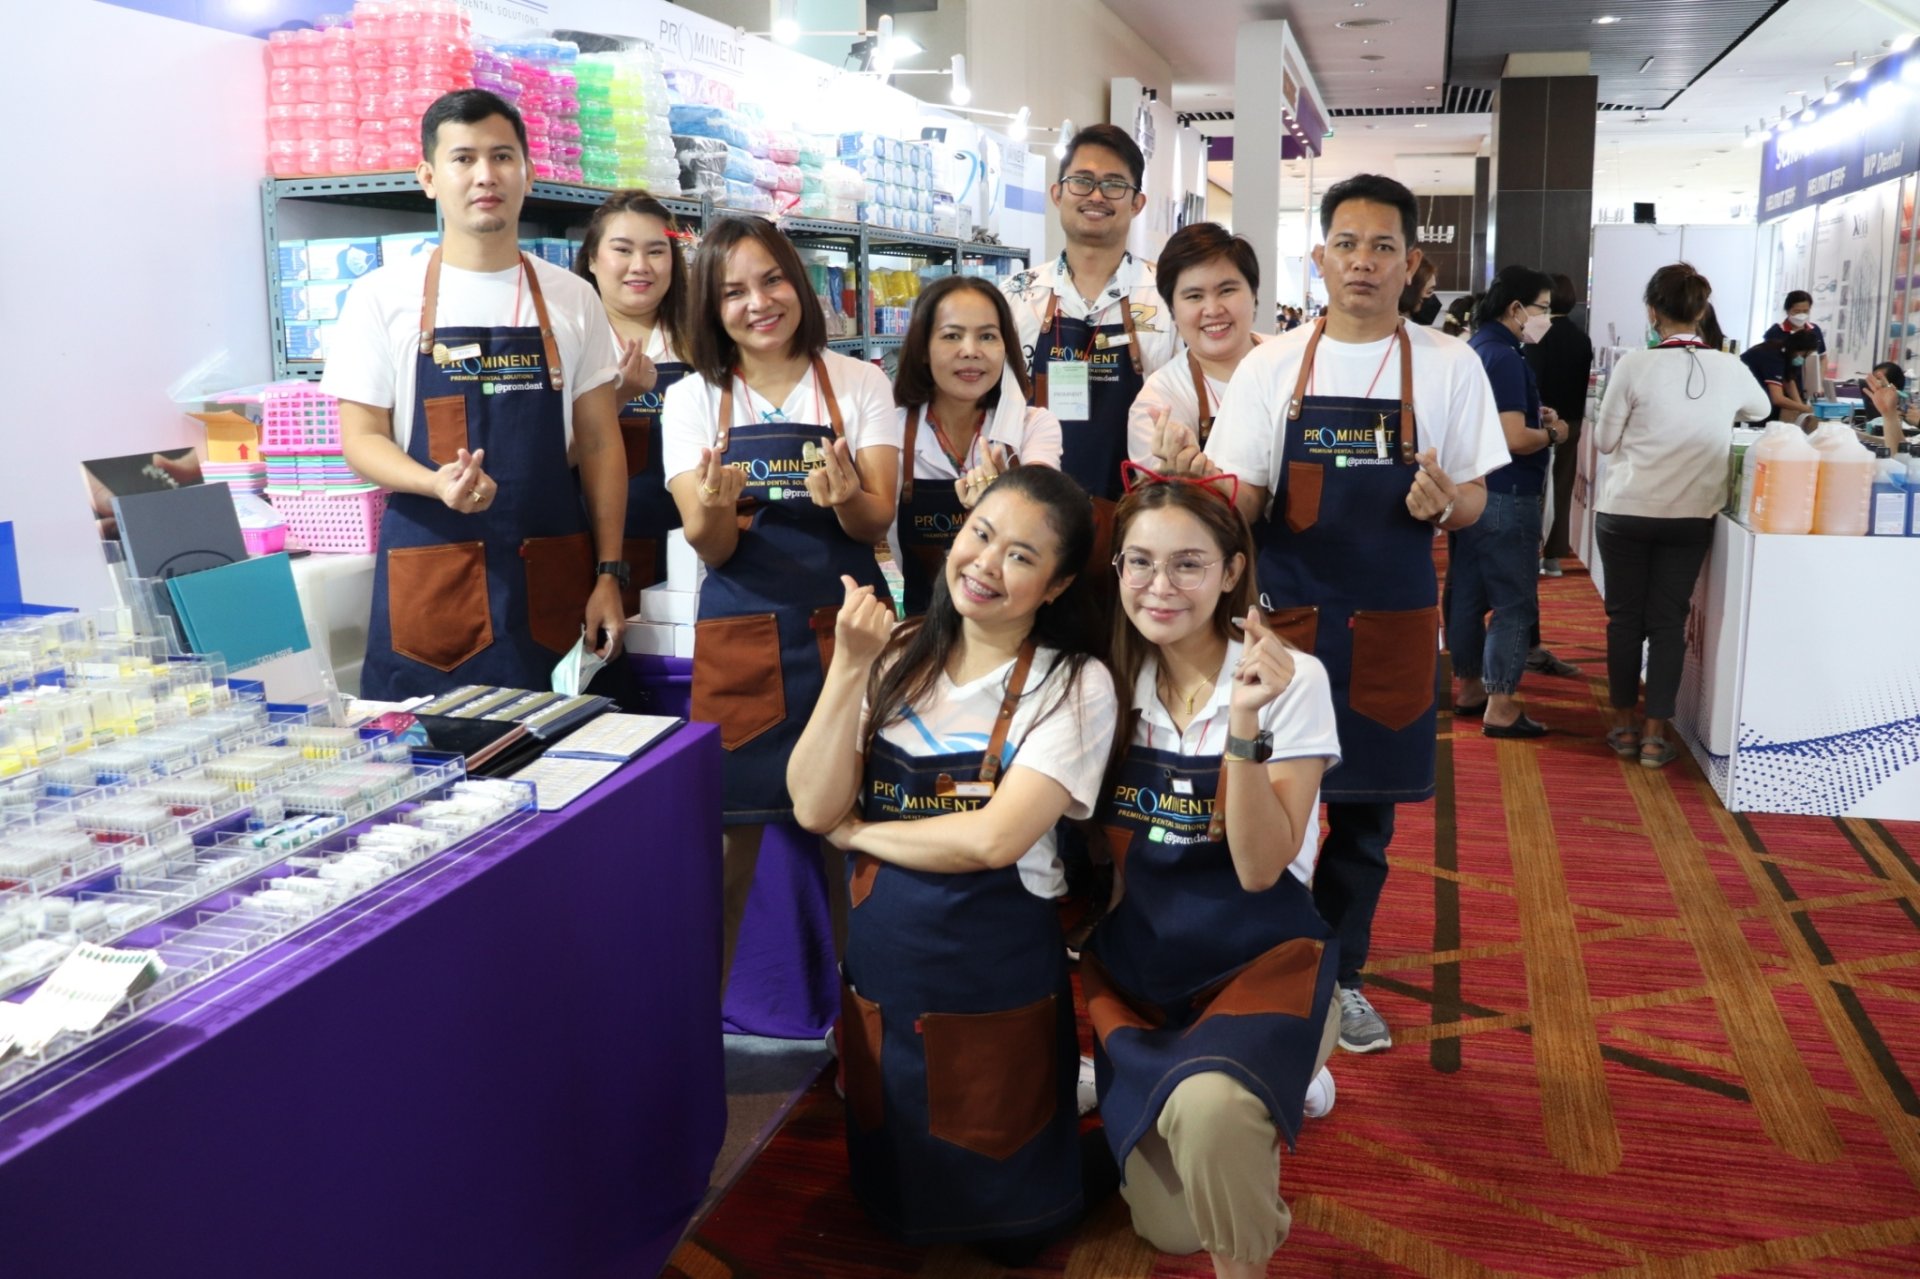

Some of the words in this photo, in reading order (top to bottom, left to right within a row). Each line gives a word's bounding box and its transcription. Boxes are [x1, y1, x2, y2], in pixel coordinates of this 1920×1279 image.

[497, 6, 540, 27] SOLUTIONS
[659, 19, 745, 67] PROMINENT
[494, 382, 543, 394] @promdent
[1304, 427, 1395, 449] PROMINET
[1346, 456, 1393, 467] @promdent
